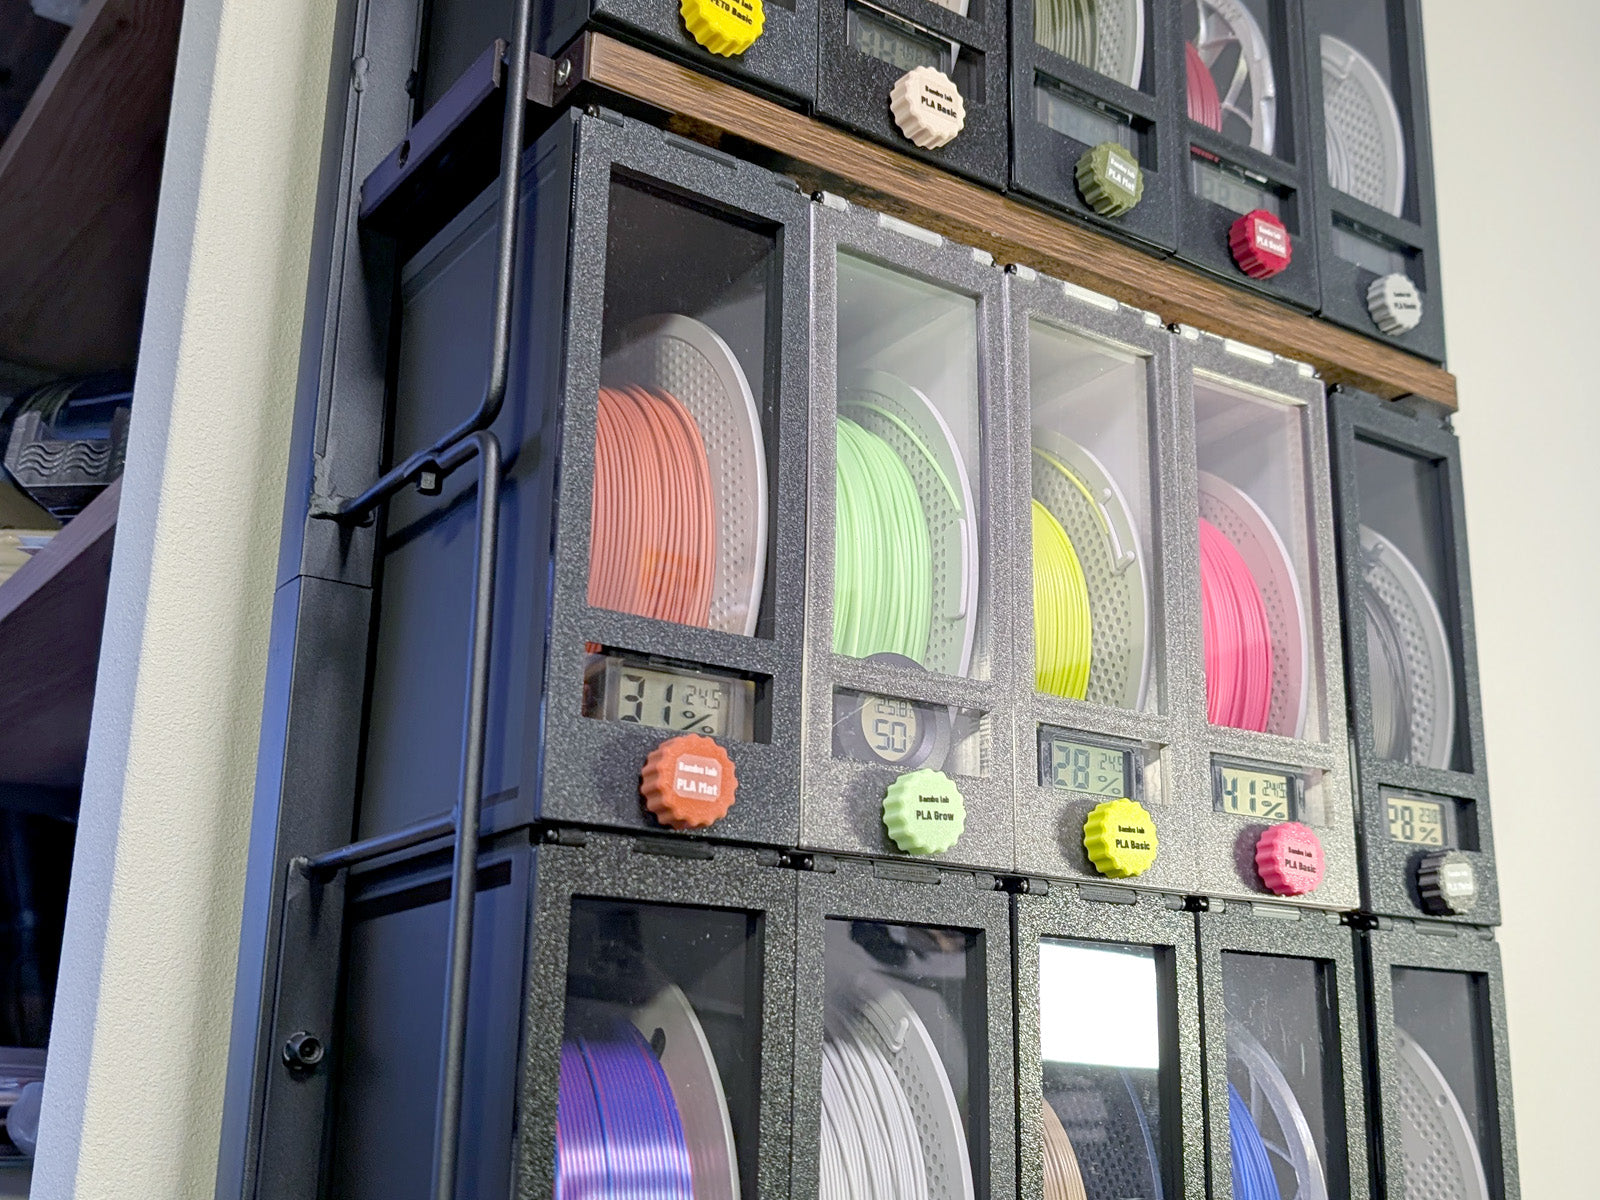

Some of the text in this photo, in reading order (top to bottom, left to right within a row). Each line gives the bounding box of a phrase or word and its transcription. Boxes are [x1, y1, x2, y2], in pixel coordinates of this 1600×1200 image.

[732, 7, 753, 26] Basic
[921, 96, 957, 119] PLA Basic
[1108, 167, 1122, 184] PLA
[1256, 235, 1269, 247] PLA
[874, 718, 907, 753] 50
[678, 761, 705, 775] Bambu
[676, 777, 718, 796] PLA Mat
[918, 795, 940, 804] Bambu
[916, 810, 954, 822] PLA Grow
[1118, 825, 1136, 834] Bambu
[1115, 839, 1151, 851] PLA Basic
[1284, 858, 1317, 874] PLA Basic
